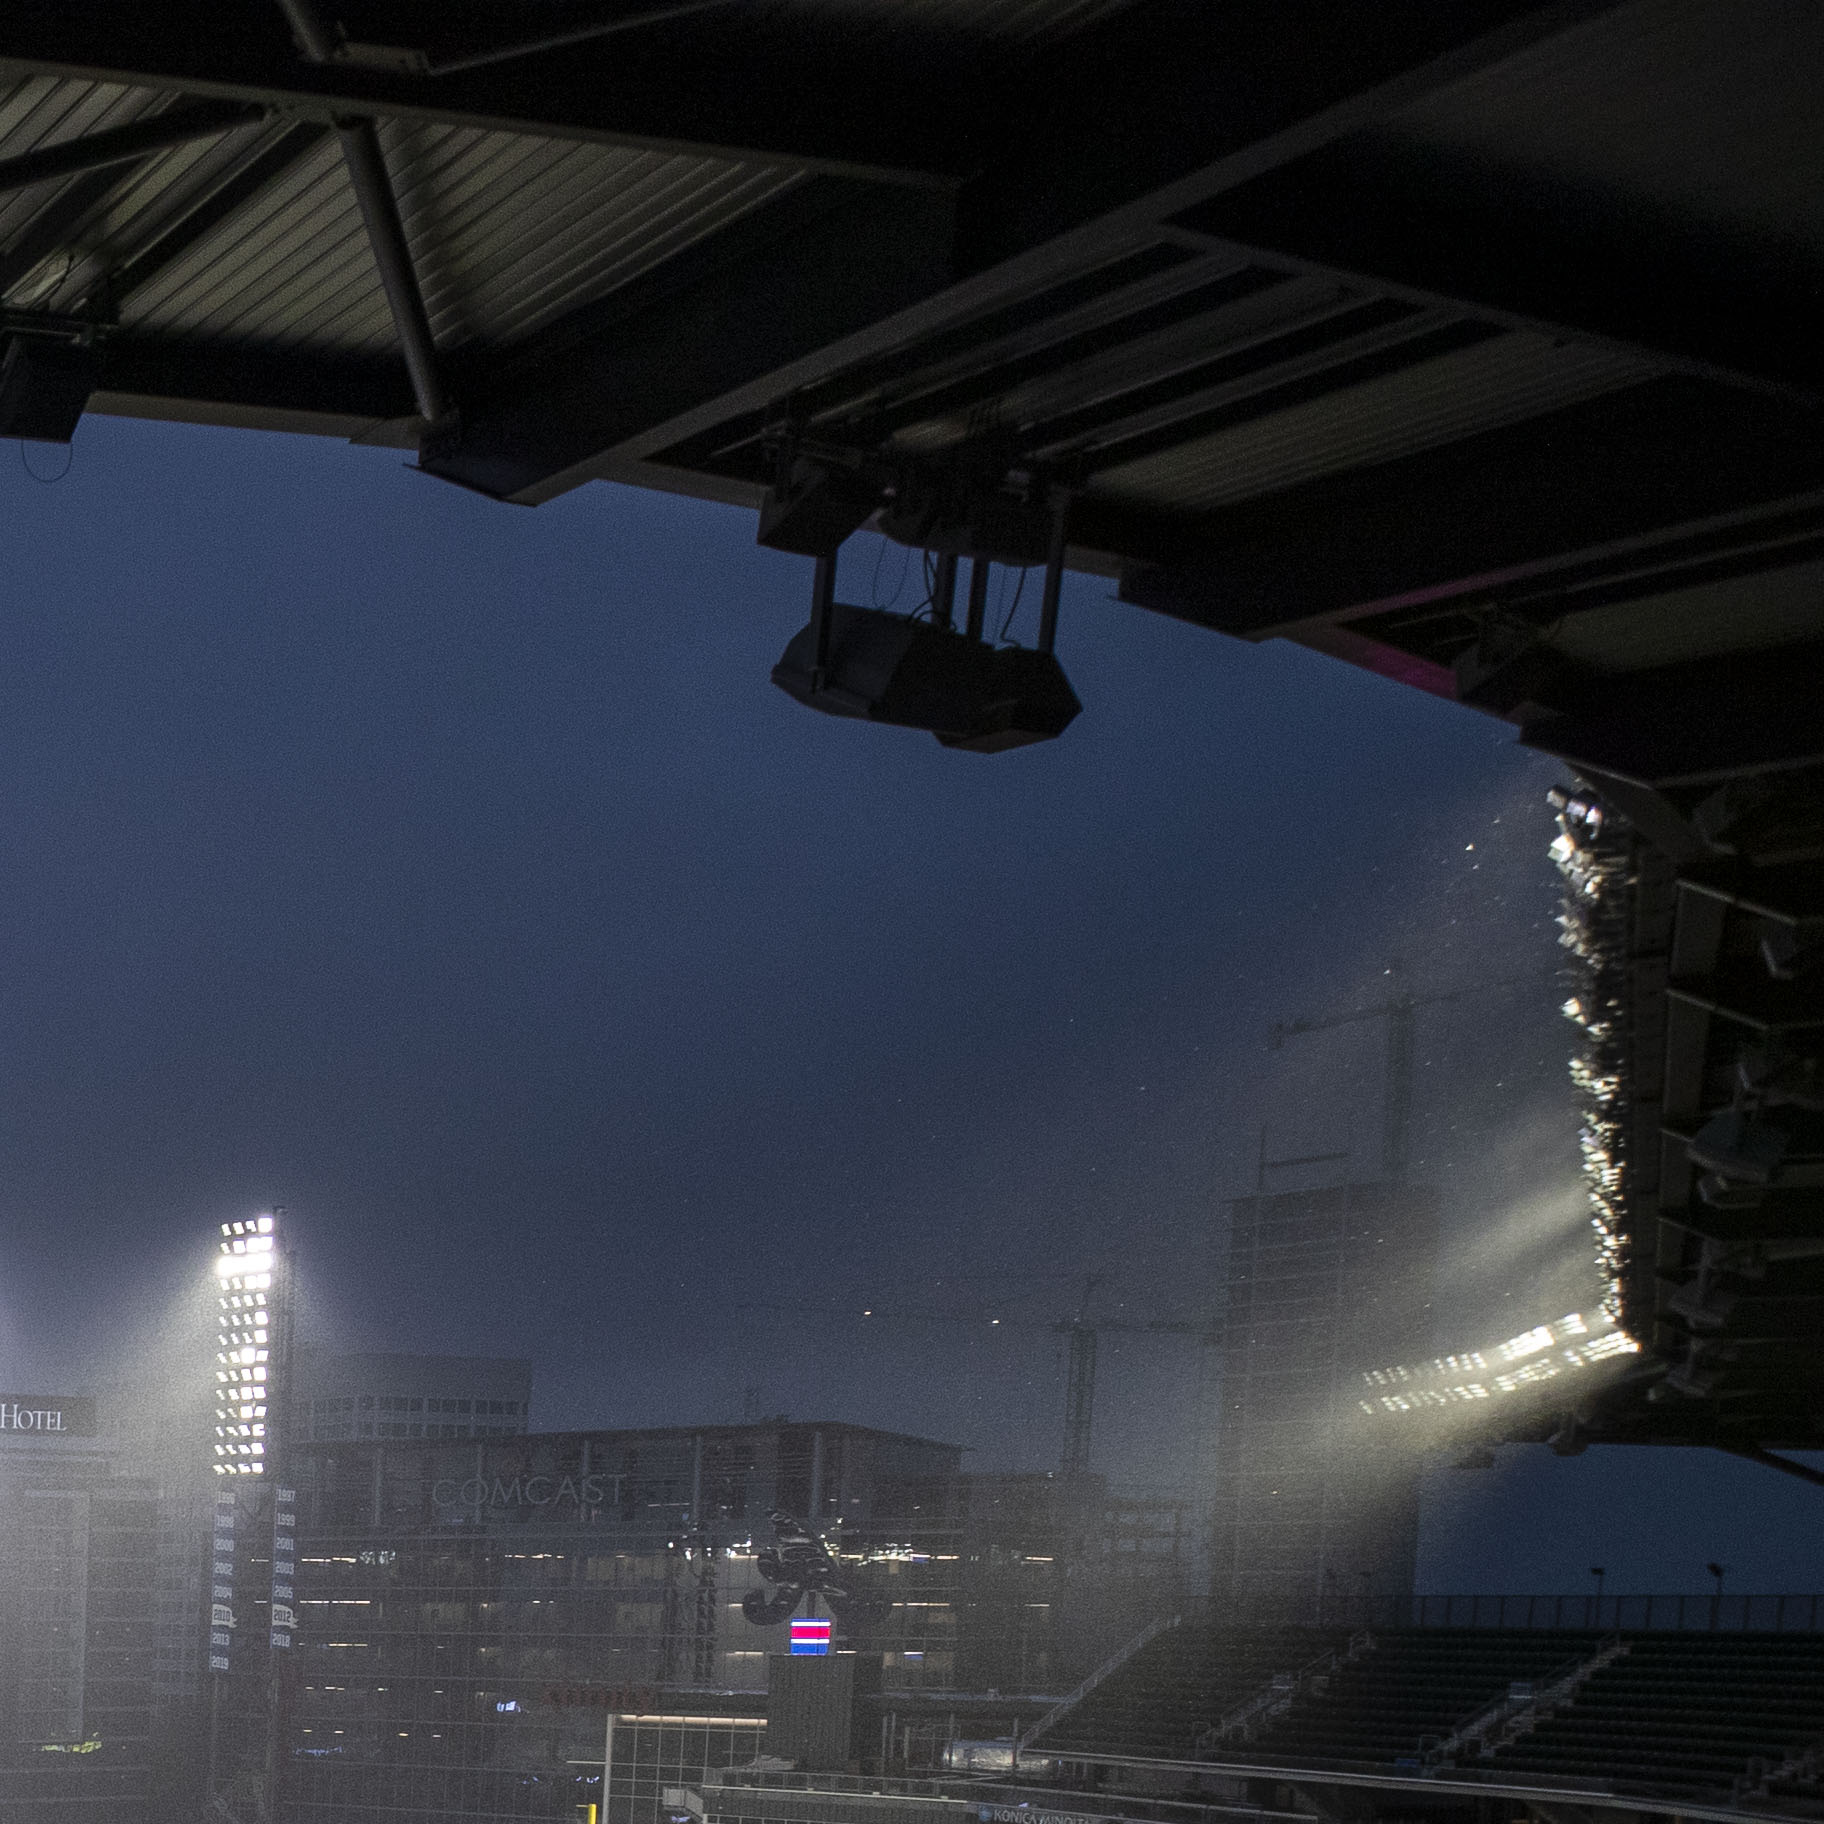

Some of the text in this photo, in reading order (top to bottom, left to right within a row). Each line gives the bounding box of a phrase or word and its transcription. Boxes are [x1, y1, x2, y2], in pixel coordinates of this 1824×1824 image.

[0, 1403, 67, 1431] HOTEL
[432, 1474, 627, 1506] COMCAST
[212, 1632, 230, 1646] 2013
